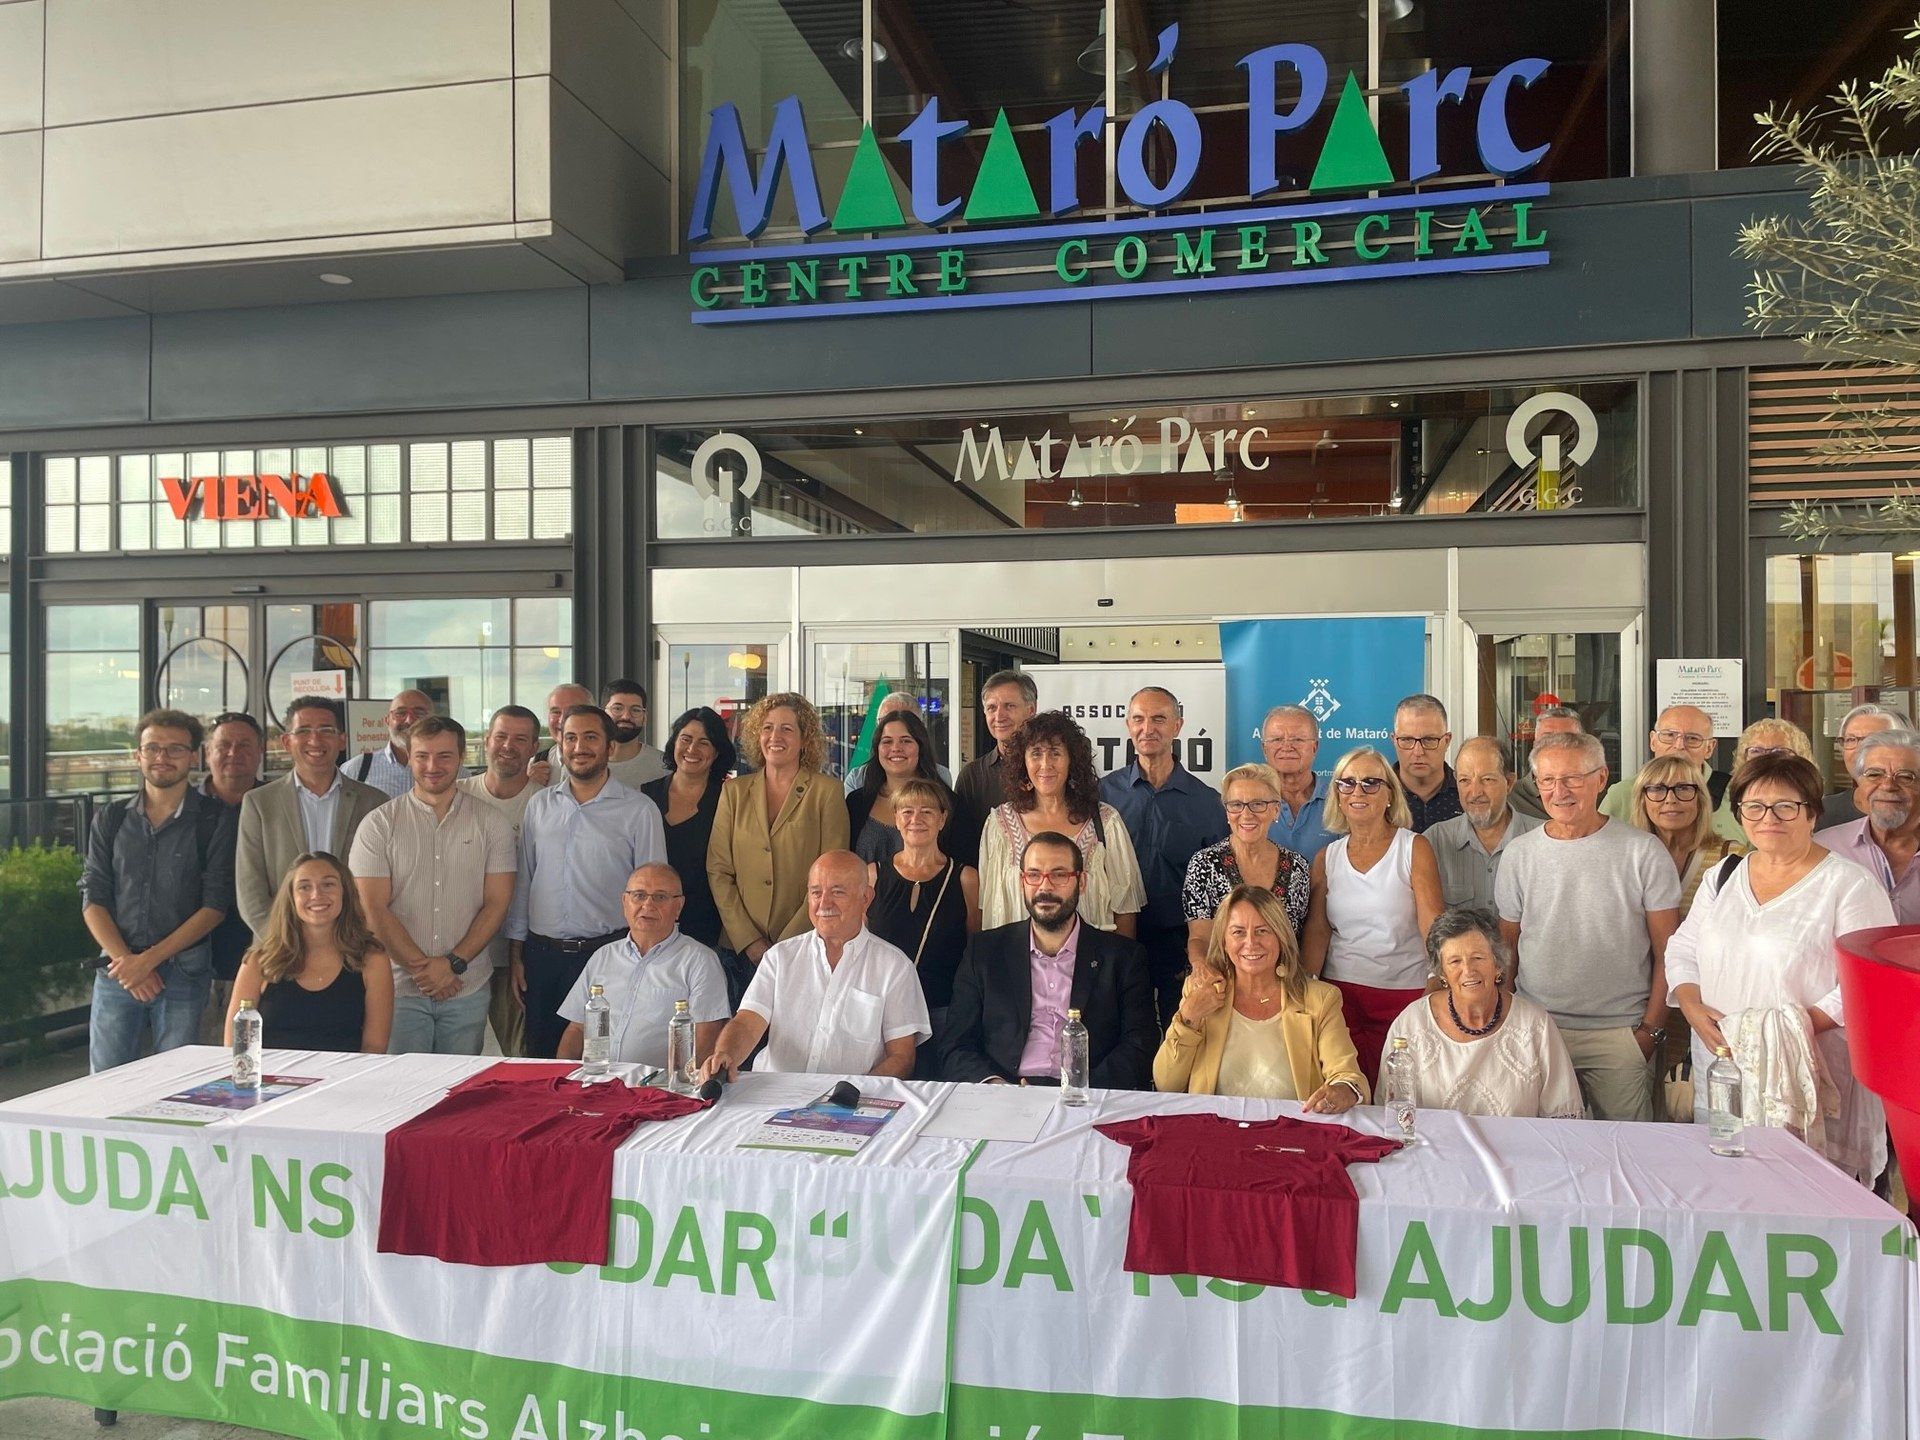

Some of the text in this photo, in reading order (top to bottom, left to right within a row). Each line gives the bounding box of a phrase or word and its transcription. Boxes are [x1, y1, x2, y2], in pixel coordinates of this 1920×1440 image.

[690, 203, 1548, 309] CENTRE COMERCIAL
[158, 472, 343, 521] VIENA
[362, 717, 376, 728] Per
[1326, 728, 1341, 739] de
[1345, 727, 1388, 739] Mataró
[1379, 1220, 1844, 1336] AJUDAR
[215, 1332, 489, 1439] Familiars
